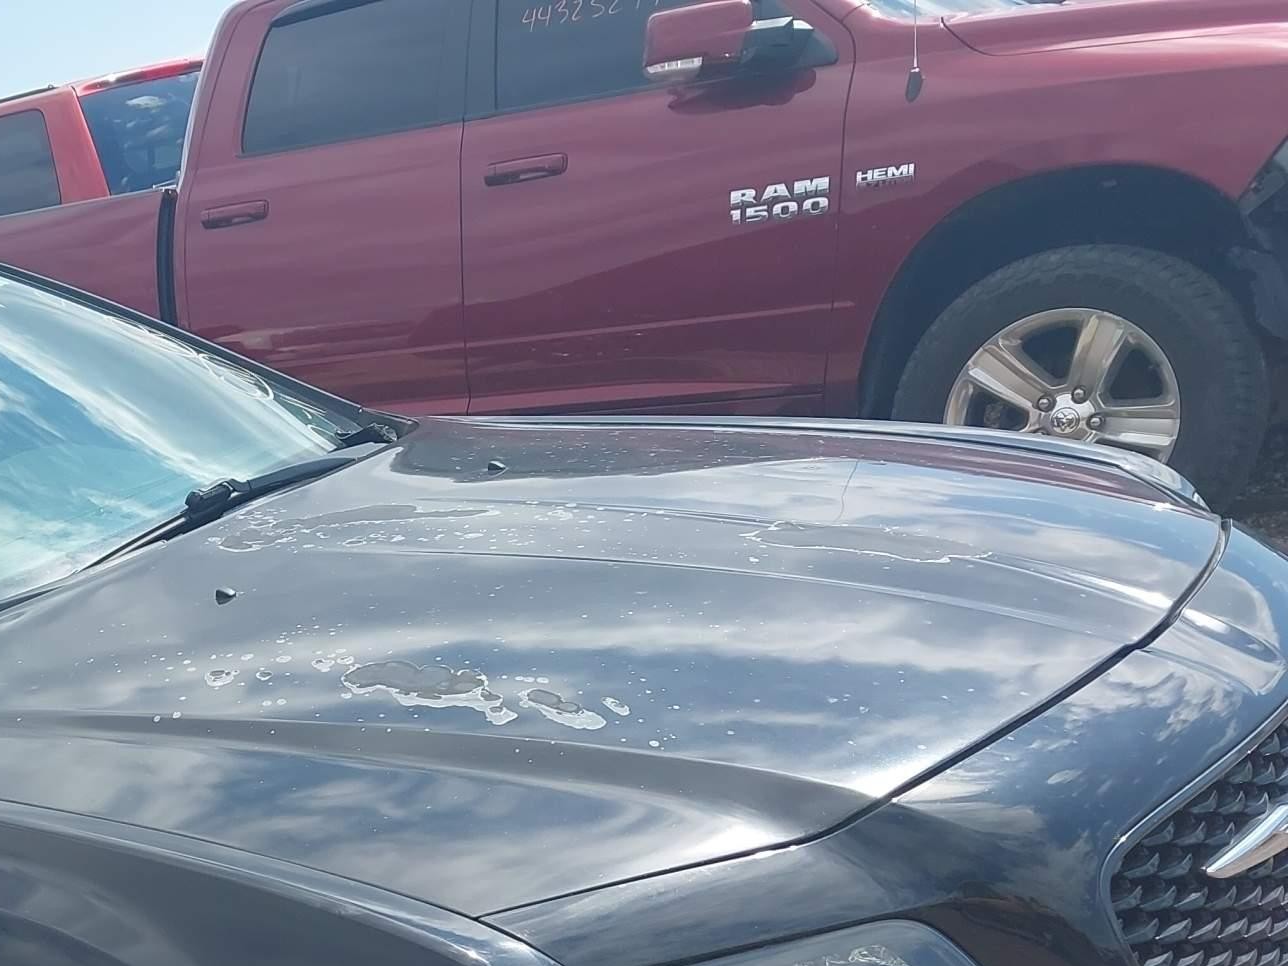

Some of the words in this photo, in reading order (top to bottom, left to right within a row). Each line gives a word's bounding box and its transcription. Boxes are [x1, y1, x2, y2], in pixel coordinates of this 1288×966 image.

[856, 163, 915, 184] HEMI
[730, 176, 830, 206] RAM
[730, 197, 830, 225] 1500
